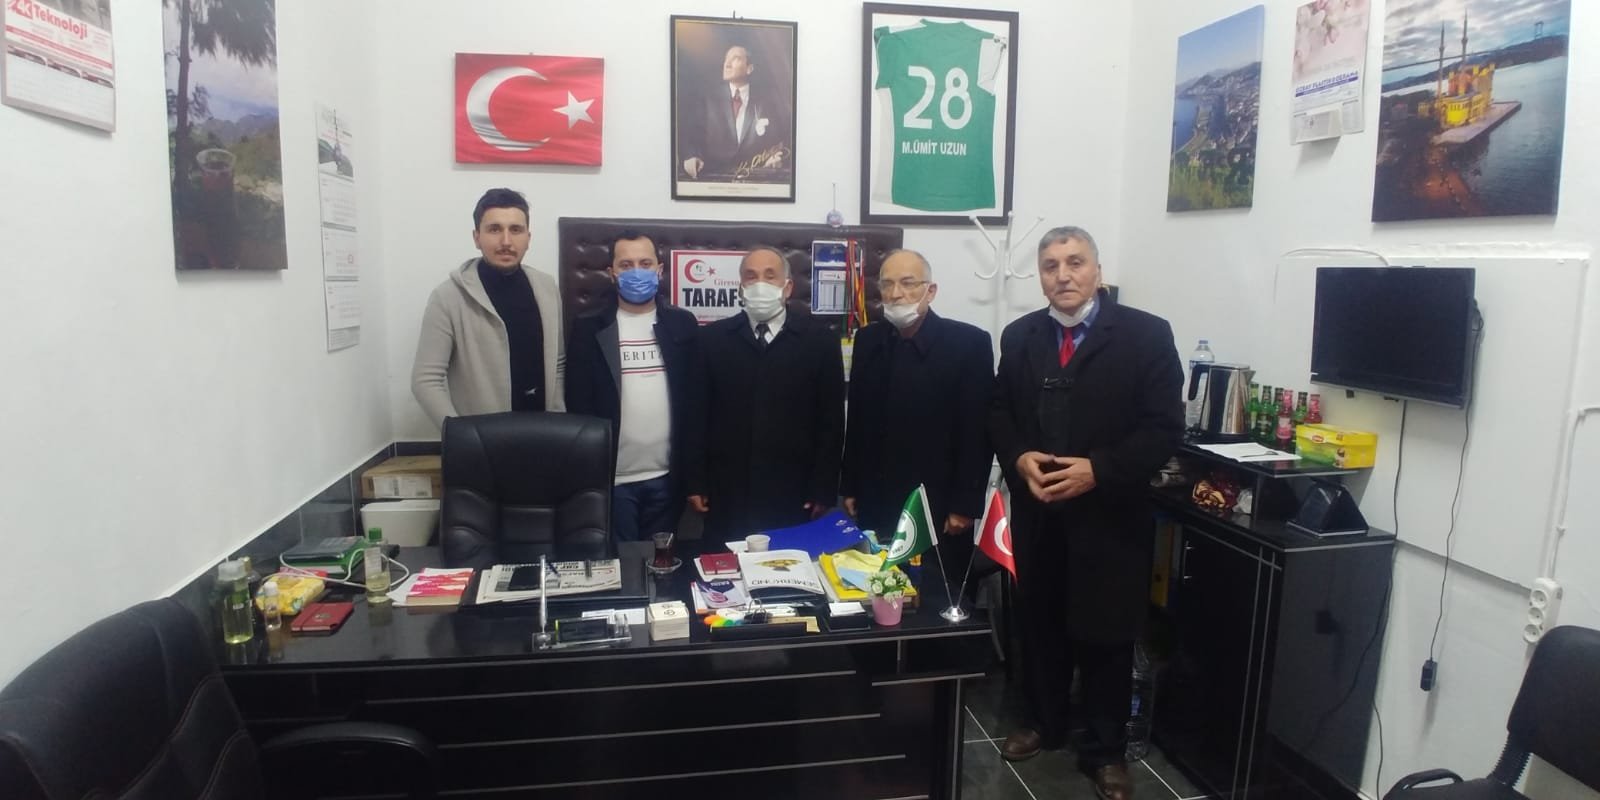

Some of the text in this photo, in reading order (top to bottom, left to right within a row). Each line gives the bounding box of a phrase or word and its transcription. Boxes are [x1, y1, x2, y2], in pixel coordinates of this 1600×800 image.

[33, 4, 88, 39] Teknoloji
[903, 65, 973, 130] 28
[902, 139, 967, 156] M.ÜMİT UZUN
